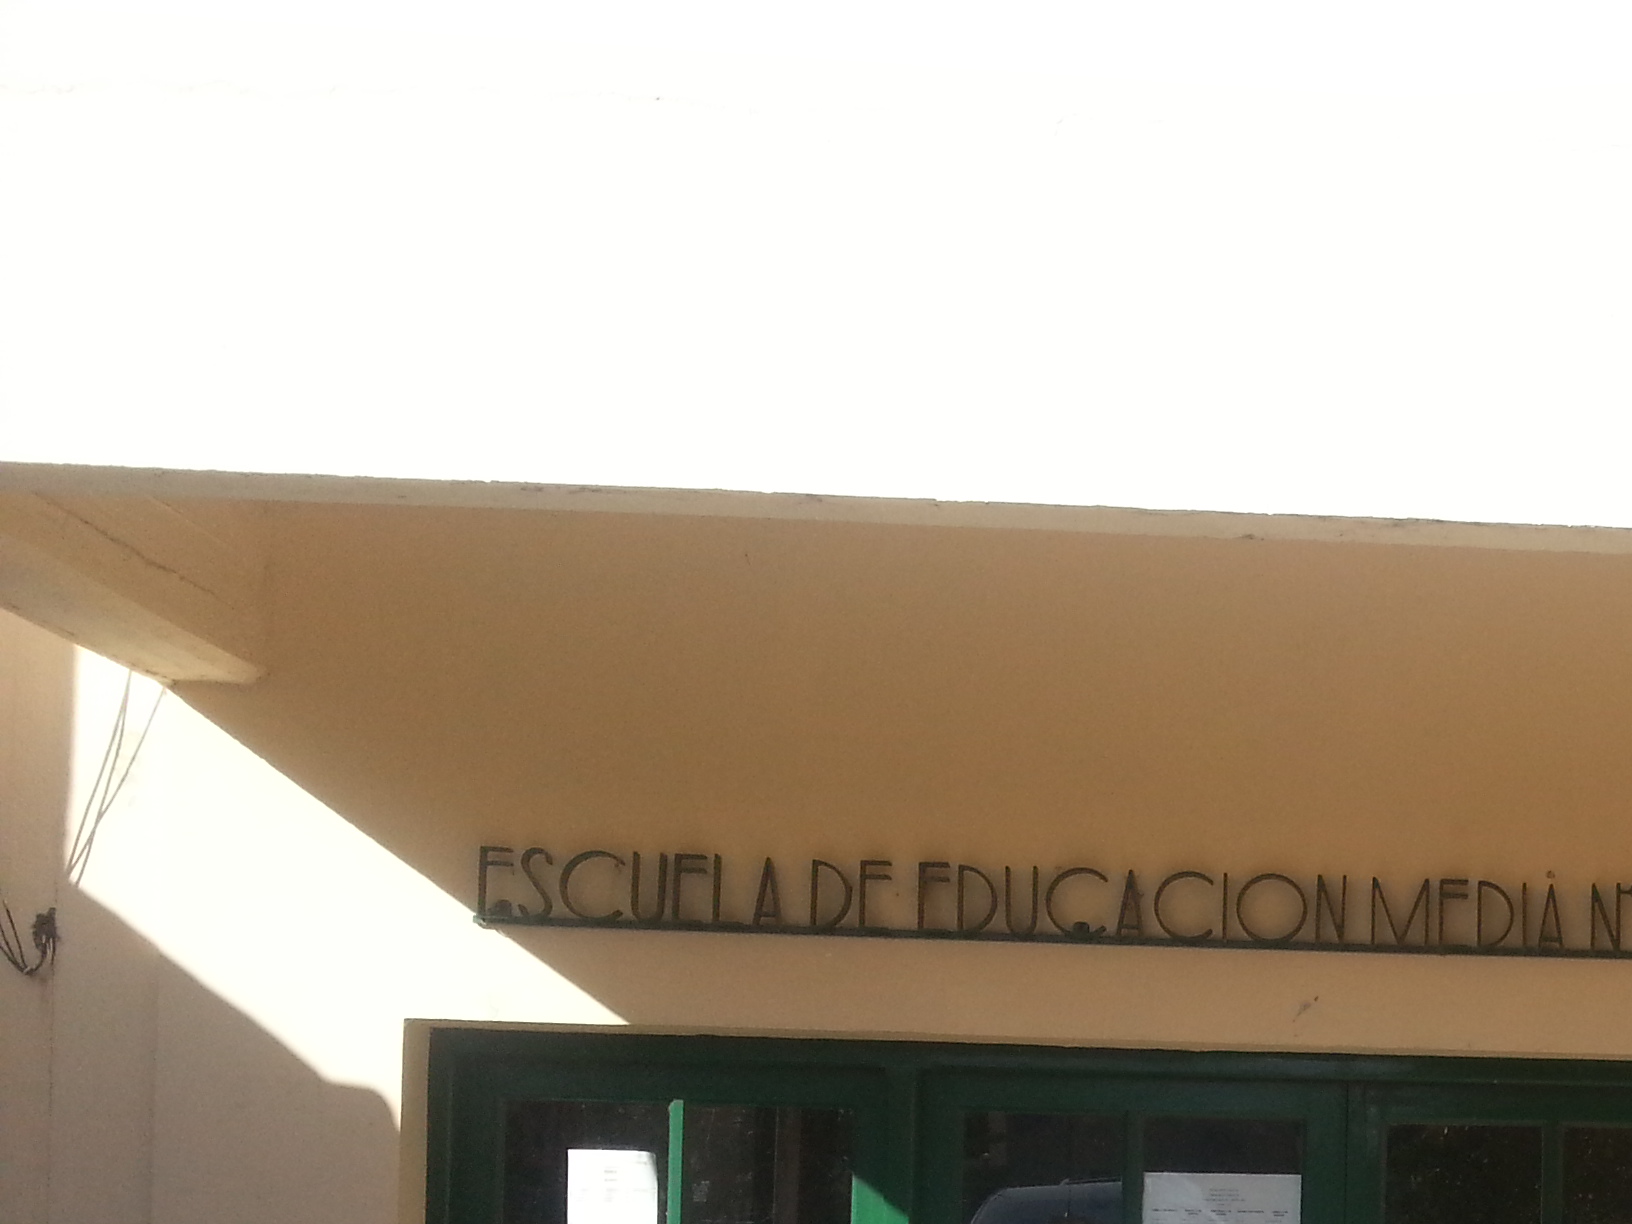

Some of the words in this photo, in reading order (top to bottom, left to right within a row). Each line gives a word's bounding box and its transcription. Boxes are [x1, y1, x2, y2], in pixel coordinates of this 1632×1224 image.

[477, 845, 782, 926] ESCUELA
[809, 858, 893, 931] DE
[917, 862, 1349, 945] EDUCACION
[1371, 875, 1565, 949] MEDIA
